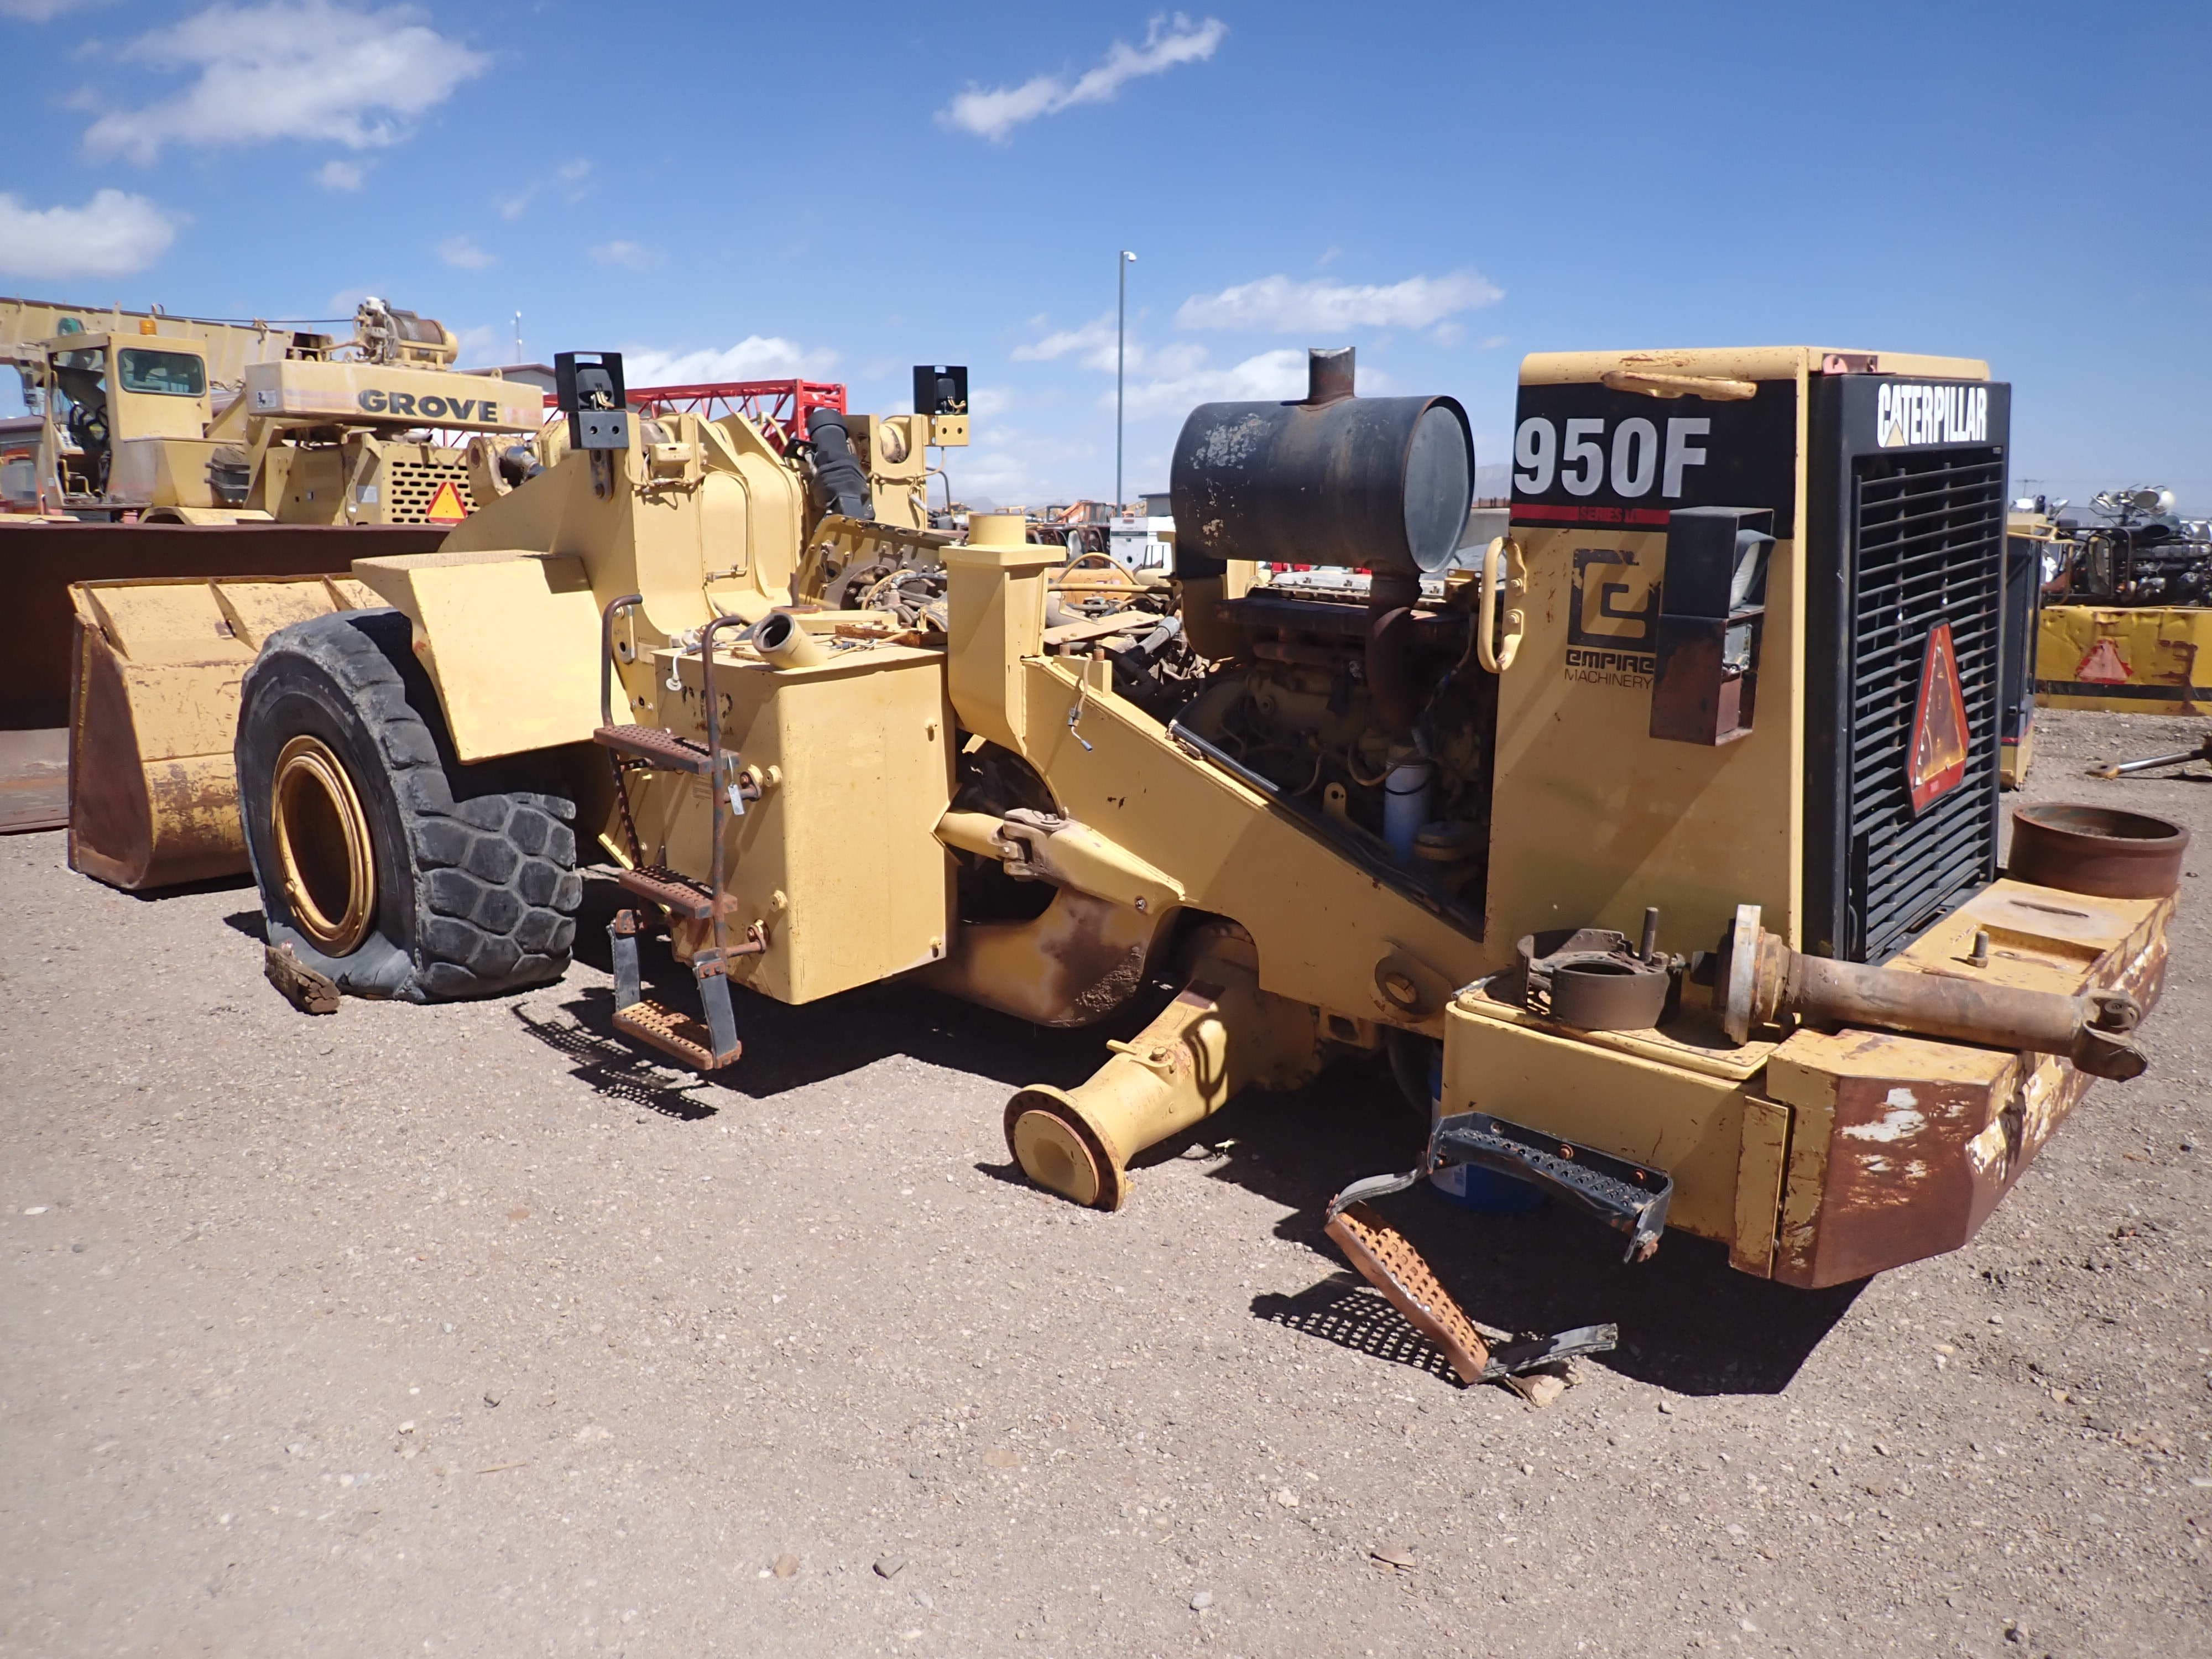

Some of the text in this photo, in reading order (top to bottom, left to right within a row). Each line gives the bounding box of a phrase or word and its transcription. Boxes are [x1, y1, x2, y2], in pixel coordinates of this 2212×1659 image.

[358, 389, 498, 422] GROVE
[1877, 383, 1987, 448] CATERPILLAR
[1514, 417, 1710, 498] 950F
[1564, 668, 1653, 690] MACHINERY
